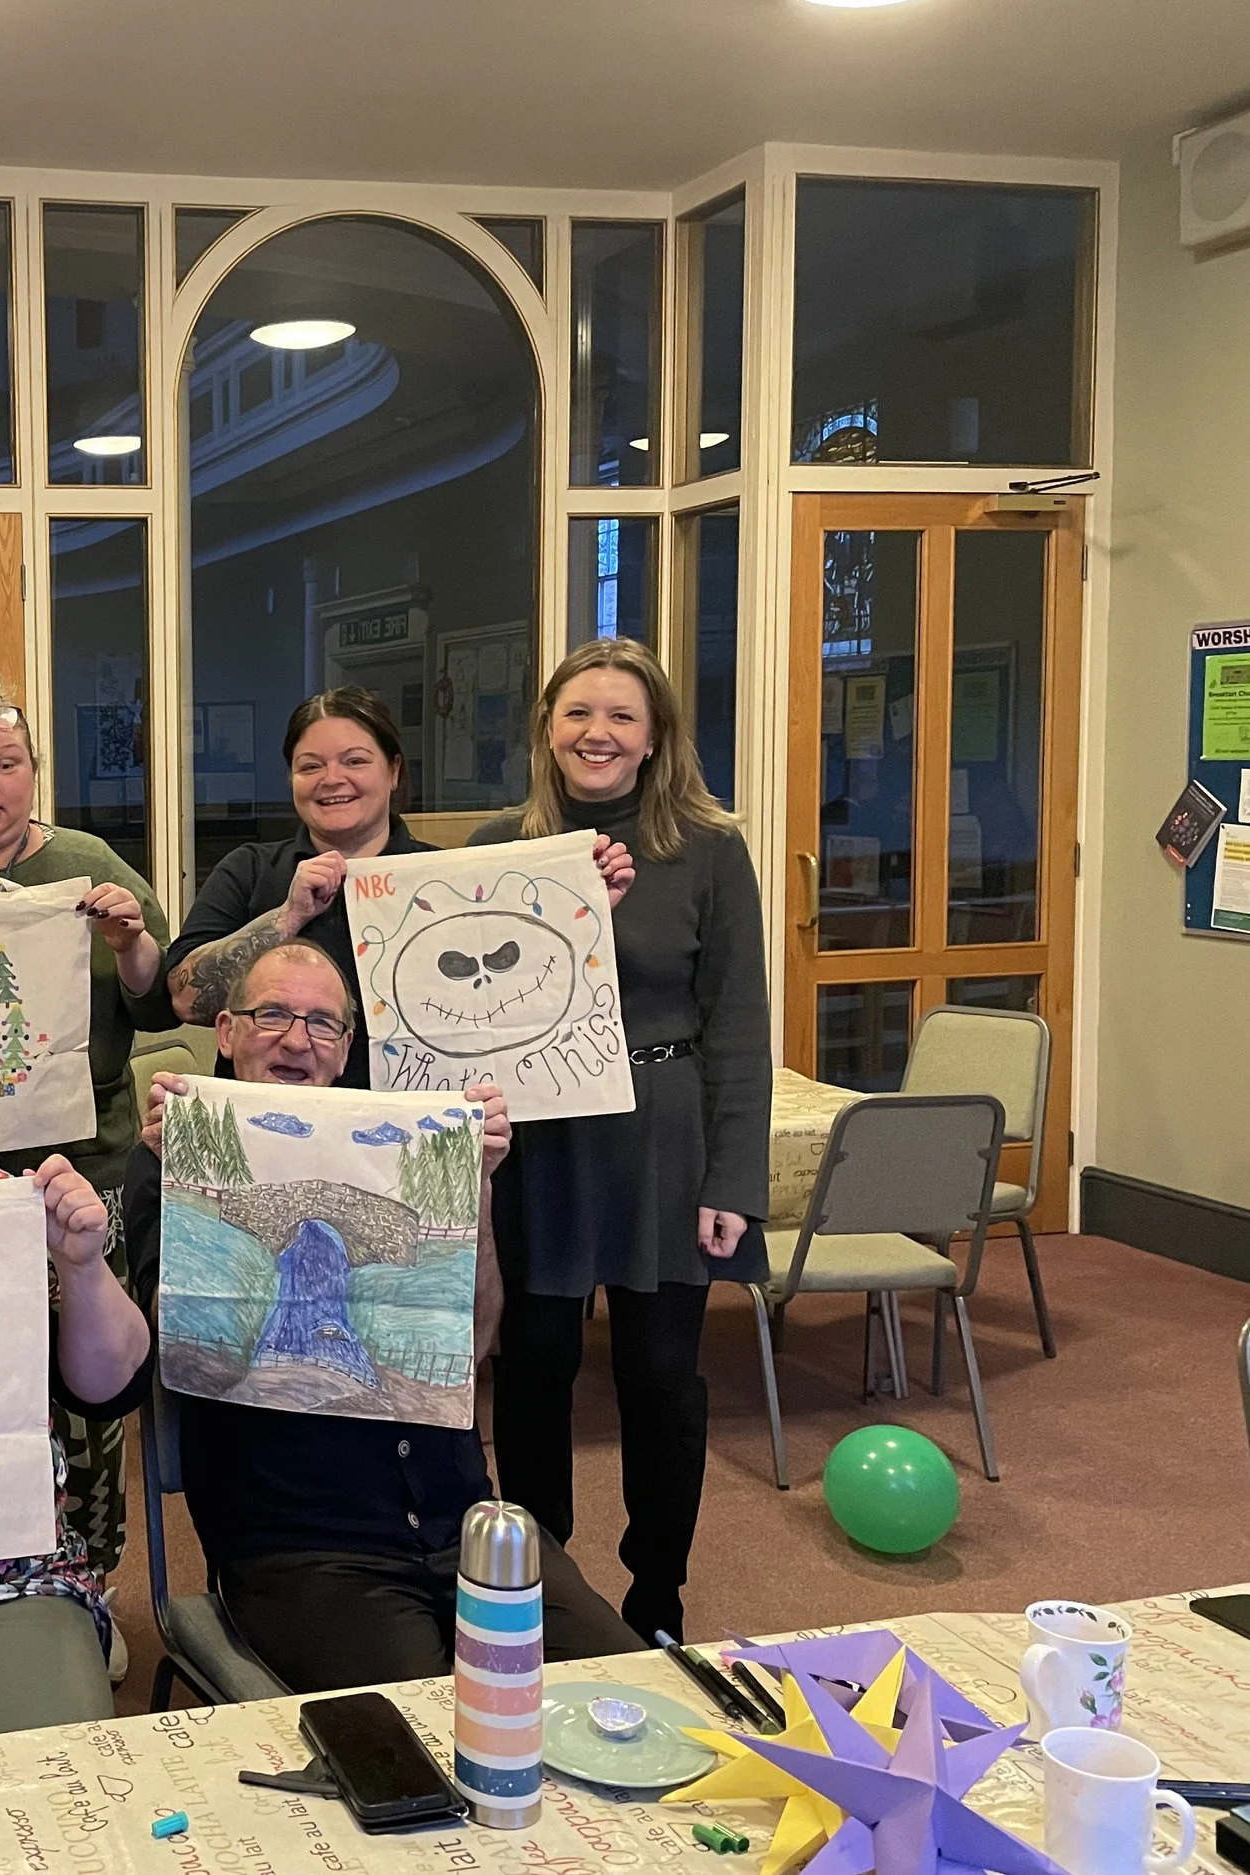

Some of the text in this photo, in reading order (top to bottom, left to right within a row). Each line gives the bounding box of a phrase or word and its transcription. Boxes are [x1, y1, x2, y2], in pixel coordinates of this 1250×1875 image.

[355, 872, 396, 900] NBC
[153, 1715, 195, 1748] cafe
[37, 1751, 78, 1780] lait
[67, 1780, 88, 1795] au
[628, 1806, 653, 1823] au
[238, 1836, 264, 1858] lait
[284, 1798, 343, 1871] cafe au lait
[646, 1826, 683, 1856] cafe
[434, 1838, 481, 1873] lait
